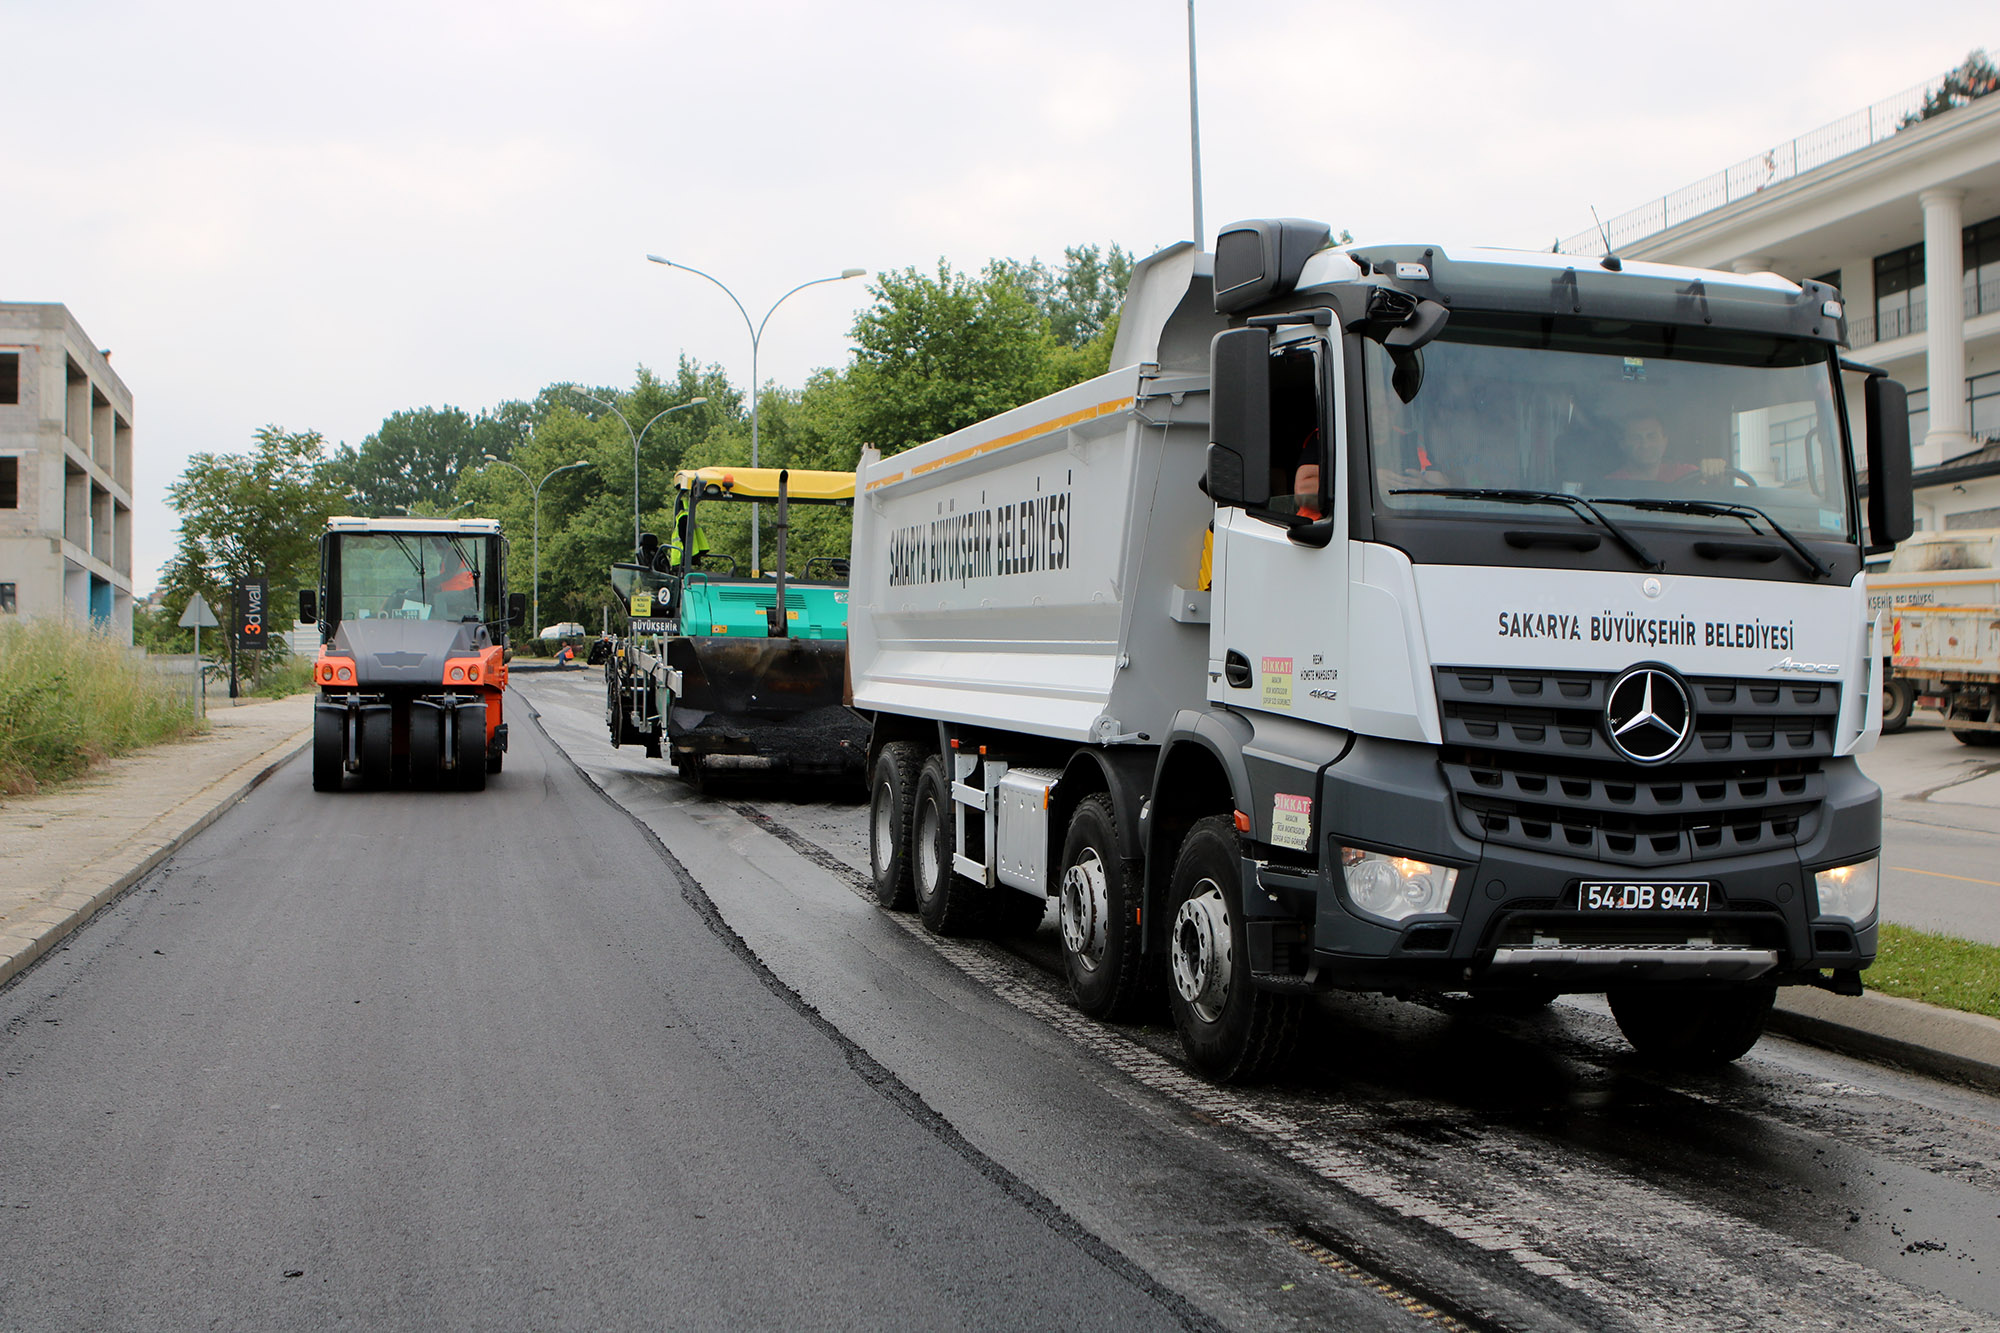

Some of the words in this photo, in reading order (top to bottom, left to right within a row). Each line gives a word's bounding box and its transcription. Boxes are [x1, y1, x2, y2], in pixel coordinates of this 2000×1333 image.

[889, 524, 927, 587] SAKARYA
[931, 490, 992, 589] BÜYÜKŞEHİR
[997, 469, 1072, 576] BELEDİYESİ
[660, 590, 668, 603] 2
[1867, 592, 1893, 610] KŞEHİR
[632, 619, 678, 632] BÜYÜKŞEHİR
[1498, 611, 1582, 641] SAKARYA
[1590, 610, 1697, 647] BÜYÜKŞEHİR
[1705, 617, 1794, 650] BELEDİYESİ
[1262, 658, 1292, 673] DİKKAT!
[1588, 886, 1615, 909] 54
[1622, 886, 1655, 909] DB
[1660, 886, 1699, 909] 944
